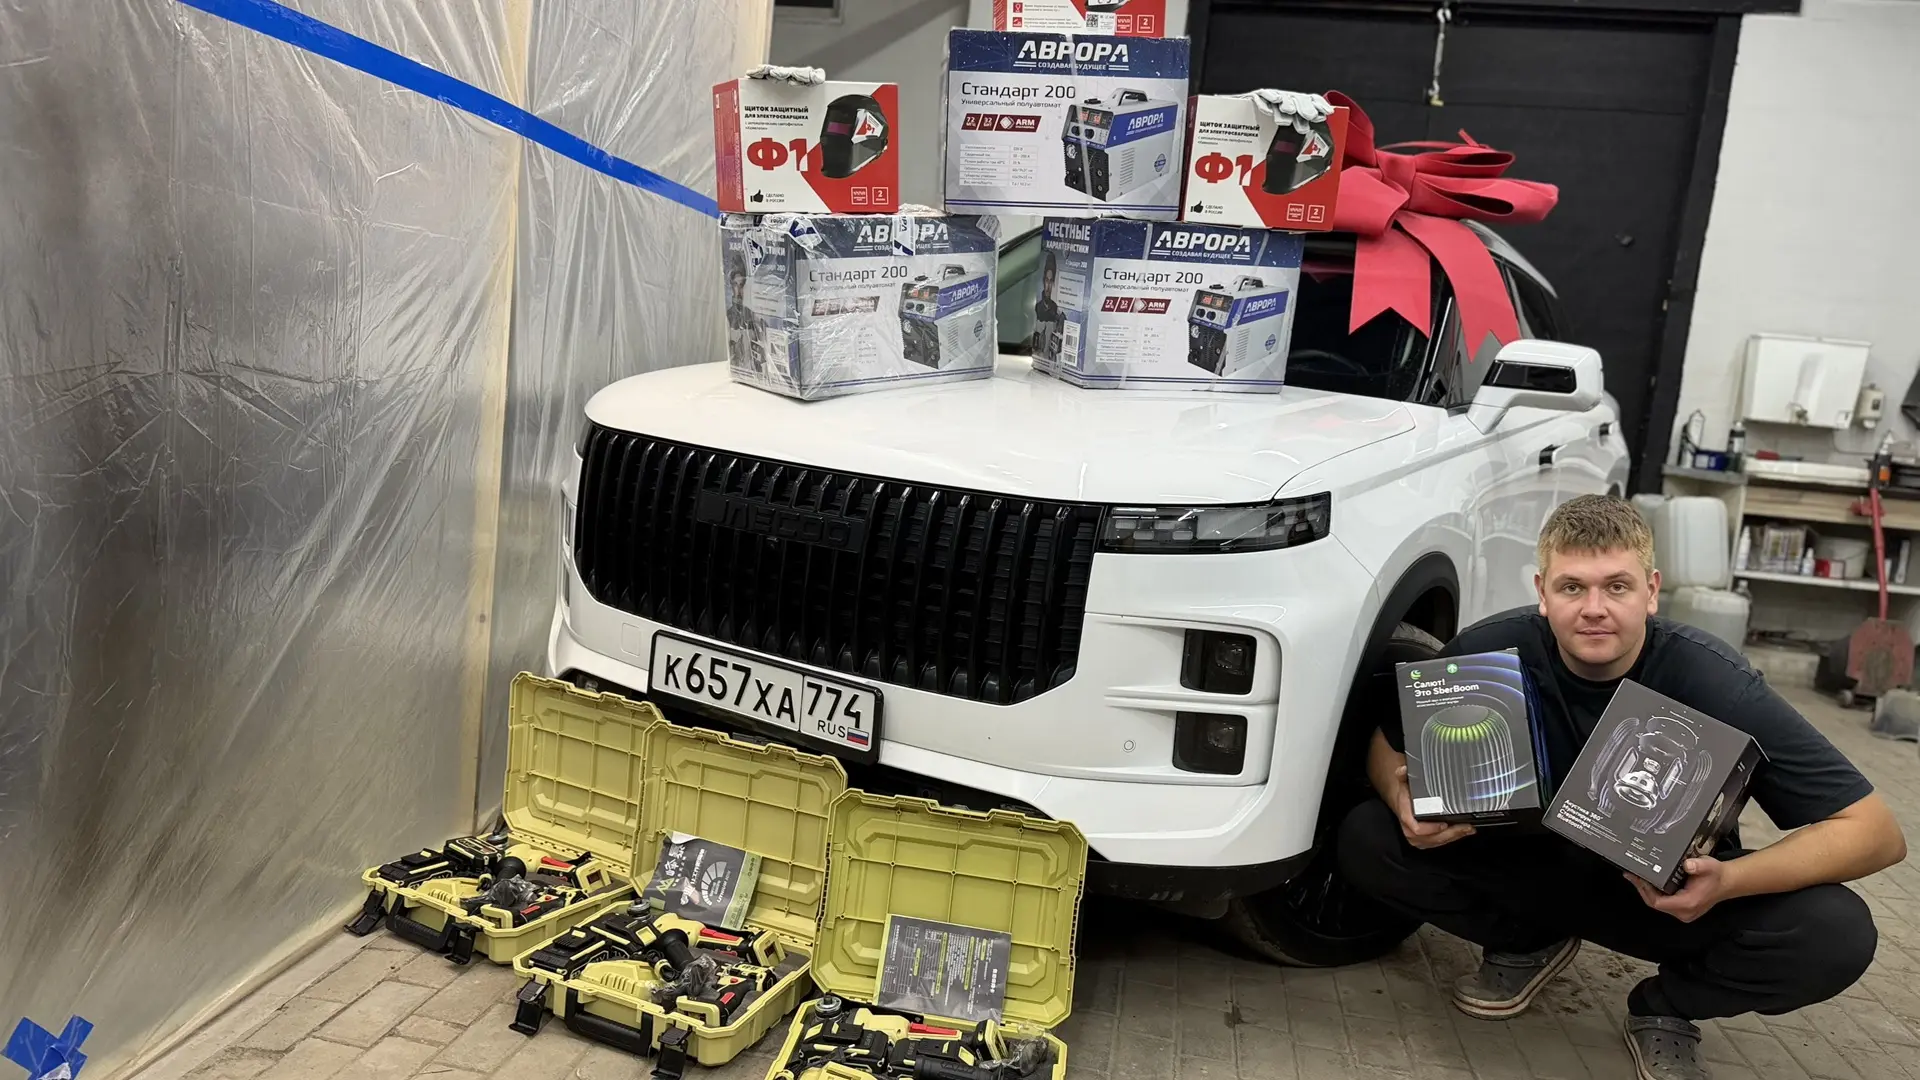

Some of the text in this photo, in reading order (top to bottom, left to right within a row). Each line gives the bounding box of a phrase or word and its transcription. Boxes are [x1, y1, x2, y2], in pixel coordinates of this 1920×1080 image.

[1017, 40, 1129, 62] АВРОРА
[962, 82, 1076, 100] Стандарт 200
[961, 98, 1015, 107] Универсальный
[1128, 112, 1164, 130] АВРОРА
[746, 138, 808, 172] Ф1
[1195, 152, 1254, 187] Ф1
[856, 224, 948, 244] АВРА
[1048, 221, 1091, 241] ЧЕСТНЫЕ
[1046, 240, 1090, 254] ХАРАКТЕРИСТИКИ
[1154, 230, 1250, 252] АВРОРА
[810, 266, 908, 283] Стандарт 200
[1104, 268, 1203, 285] Стандарт 200
[1244, 298, 1276, 313] АВРОРА
[1414, 678, 1446, 689] Салют!
[1433, 684, 1480, 695] SberBoom
[806, 681, 861, 729] 774
[817, 719, 846, 738] RUS
[1562, 804, 1592, 822] Мультирум
[1565, 800, 1590, 815] Акустика
[1557, 813, 1583, 830] Bluetooth
[1560, 809, 1590, 828] Стереопара
